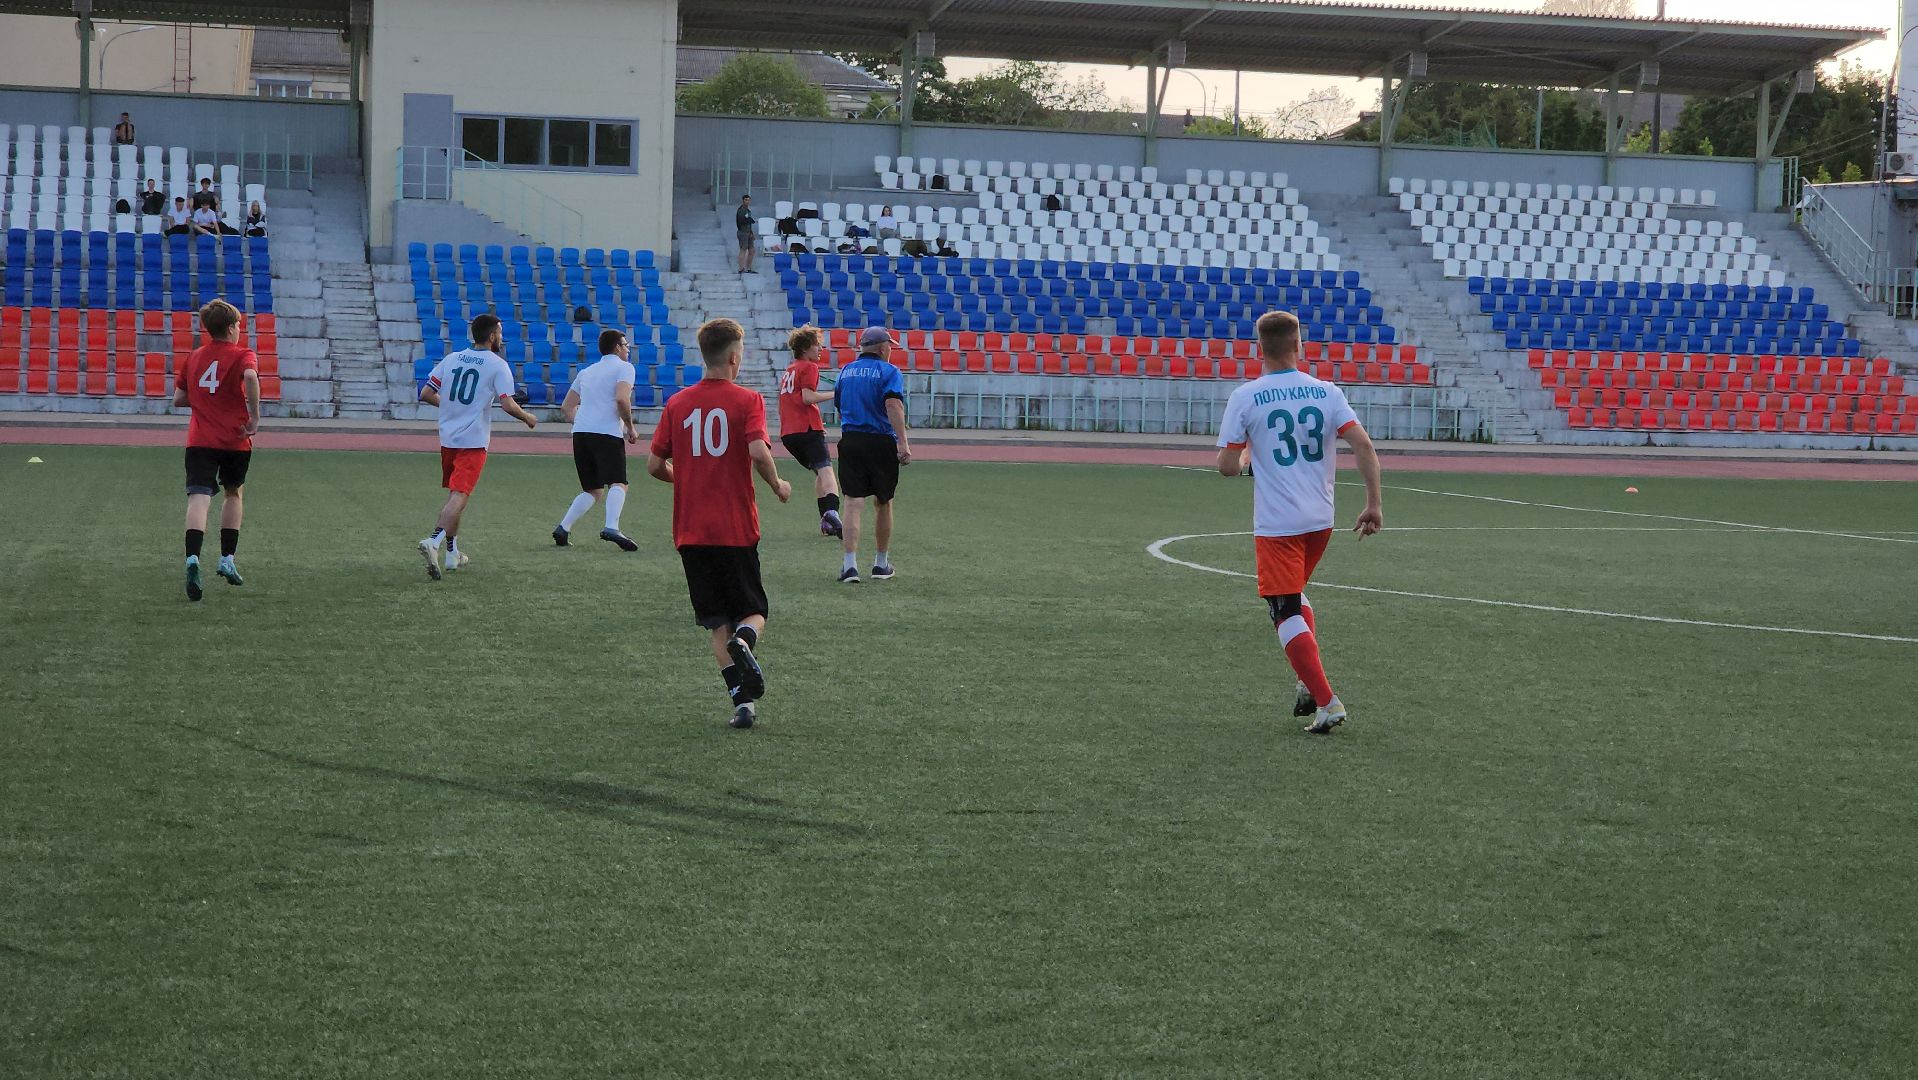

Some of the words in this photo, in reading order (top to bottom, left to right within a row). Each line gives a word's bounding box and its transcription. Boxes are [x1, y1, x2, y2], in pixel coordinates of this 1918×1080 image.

[199, 360, 220, 394] 4
[449, 366, 480, 405] 10
[780, 370, 796, 395] 20
[1254, 386, 1327, 407] ПОЛУКАРОВ
[683, 407, 729, 457] 10
[1267, 405, 1325, 467] 33
